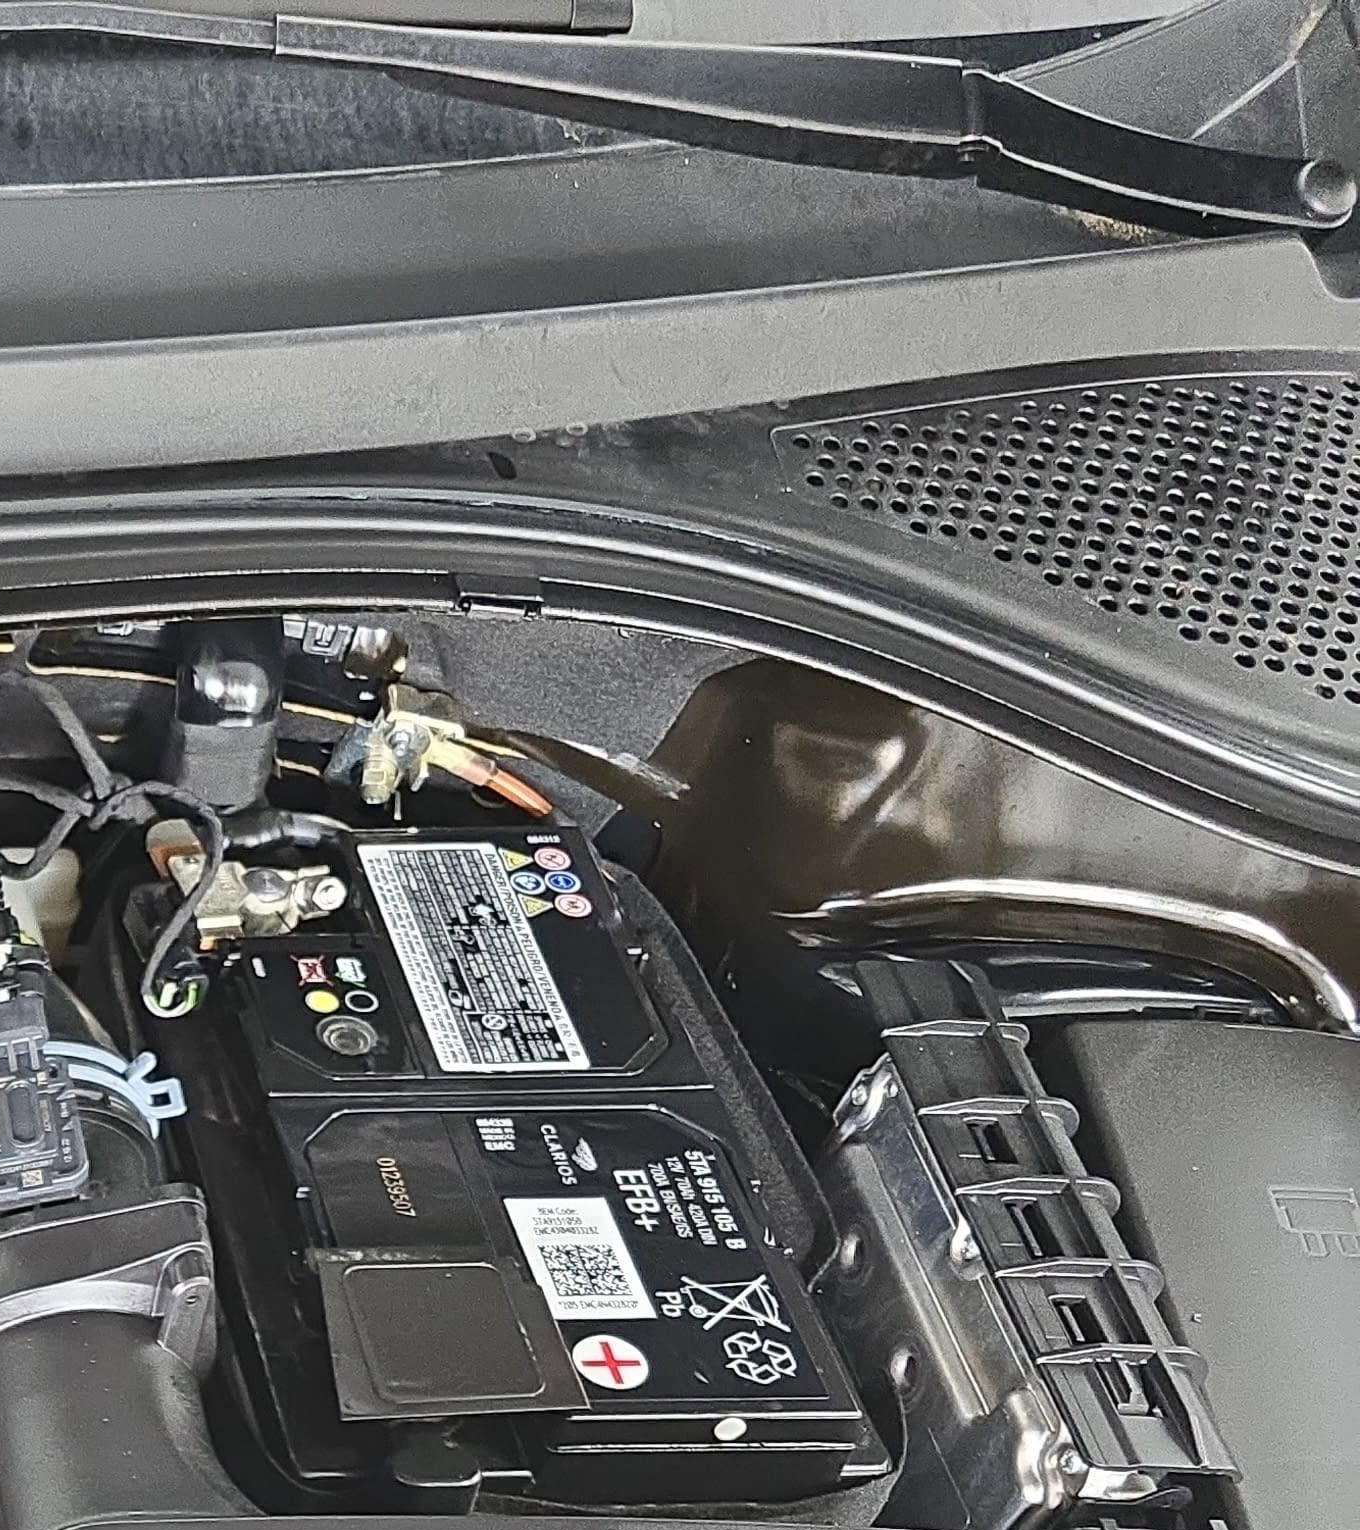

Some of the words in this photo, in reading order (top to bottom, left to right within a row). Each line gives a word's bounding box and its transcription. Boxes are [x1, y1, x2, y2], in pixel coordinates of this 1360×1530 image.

[540, 1123, 578, 1186] CLARIOS
[664, 1156, 685, 1174] 12V
[684, 1150, 710, 1177] 5TA
[376, 1157, 417, 1217] 01239507
[647, 1162, 671, 1186] 700A
[612, 1168, 660, 1233] EFB+
[674, 1177, 698, 1200] 70Ah
[696, 1177, 726, 1204] 915
[687, 1203, 708, 1227] 420A
[710, 1205, 740, 1232] 105
[697, 1226, 718, 1246] DIN
[725, 1236, 748, 1251] B
[655, 1290, 682, 1318] Pb
